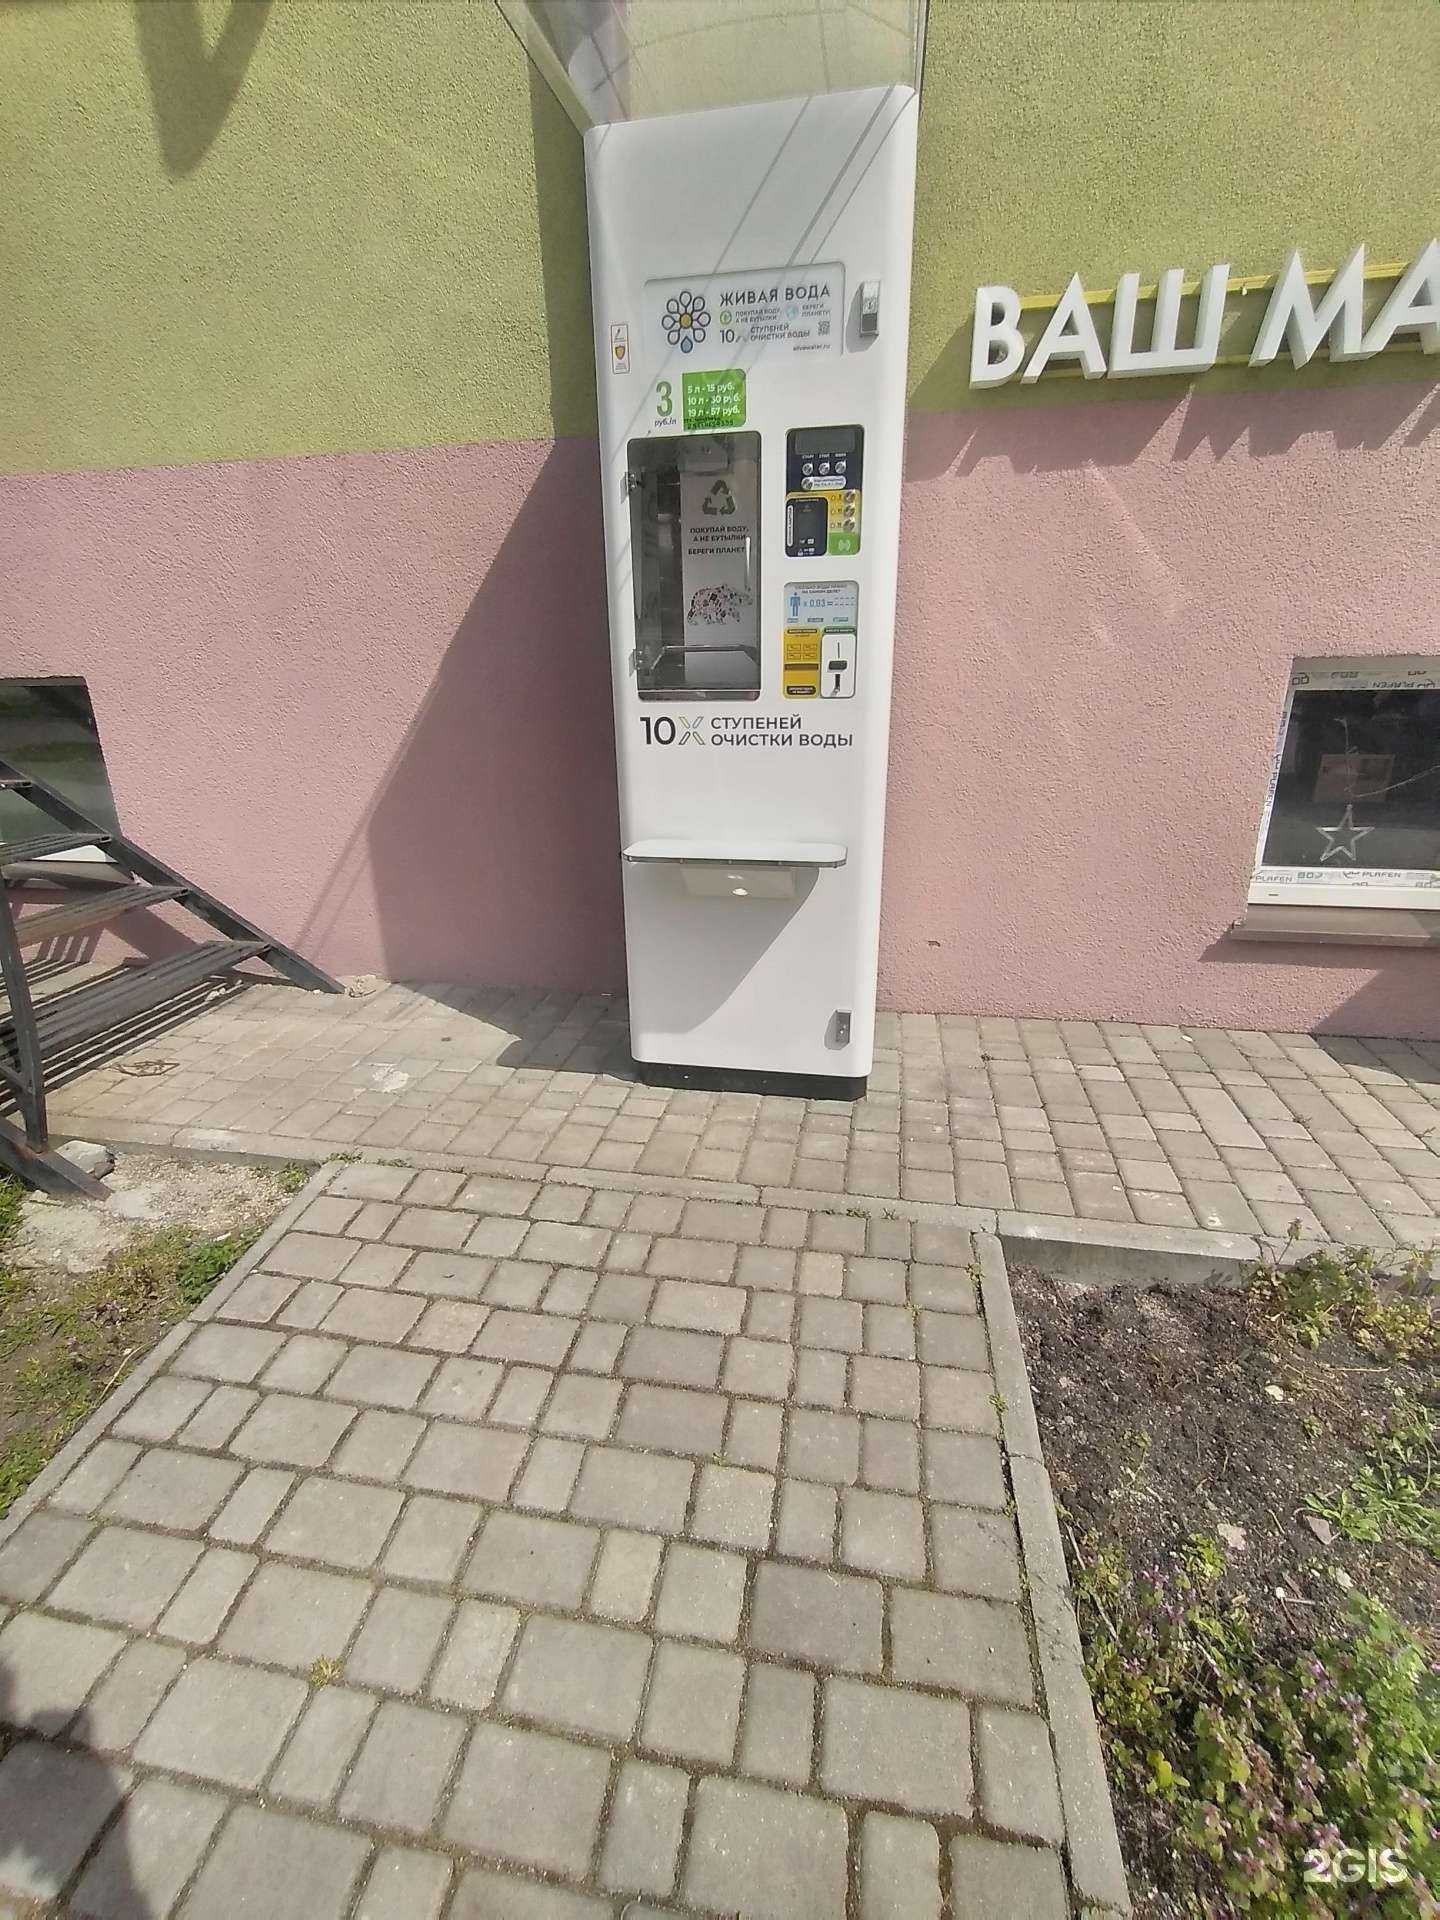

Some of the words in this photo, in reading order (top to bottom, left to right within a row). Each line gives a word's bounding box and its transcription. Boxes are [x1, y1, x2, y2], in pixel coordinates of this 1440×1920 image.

[720, 288, 778, 307] ЖИВАЯ
[785, 285, 830, 301] ВОДА
[750, 322, 790, 334] СТУПЕНЕЙ
[970, 264, 1231, 389] ВАШ
[750, 333, 785, 342] ОЧИСТКИ
[787, 330, 810, 339] ВОДЫ
[688, 385, 693, 394] 5
[694, 386, 700, 394] л
[707, 384, 716, 393] 15
[717, 382, 735, 393] руб.
[656, 381, 673, 417] 3
[688, 397, 697, 406] 10
[698, 397, 704, 405] л
[723, 393, 741, 404] руб.
[688, 408, 697, 417] 19
[711, 407, 720, 416] 57
[722, 405, 741, 417] руб.
[715, 546, 746, 554] ПЛАНЕТ
[711, 714, 801, 729] СТУПЕНЕЙ
[711, 734, 793, 746] ОЧИСТКИ
[799, 734, 853, 748] ВОДЫ
